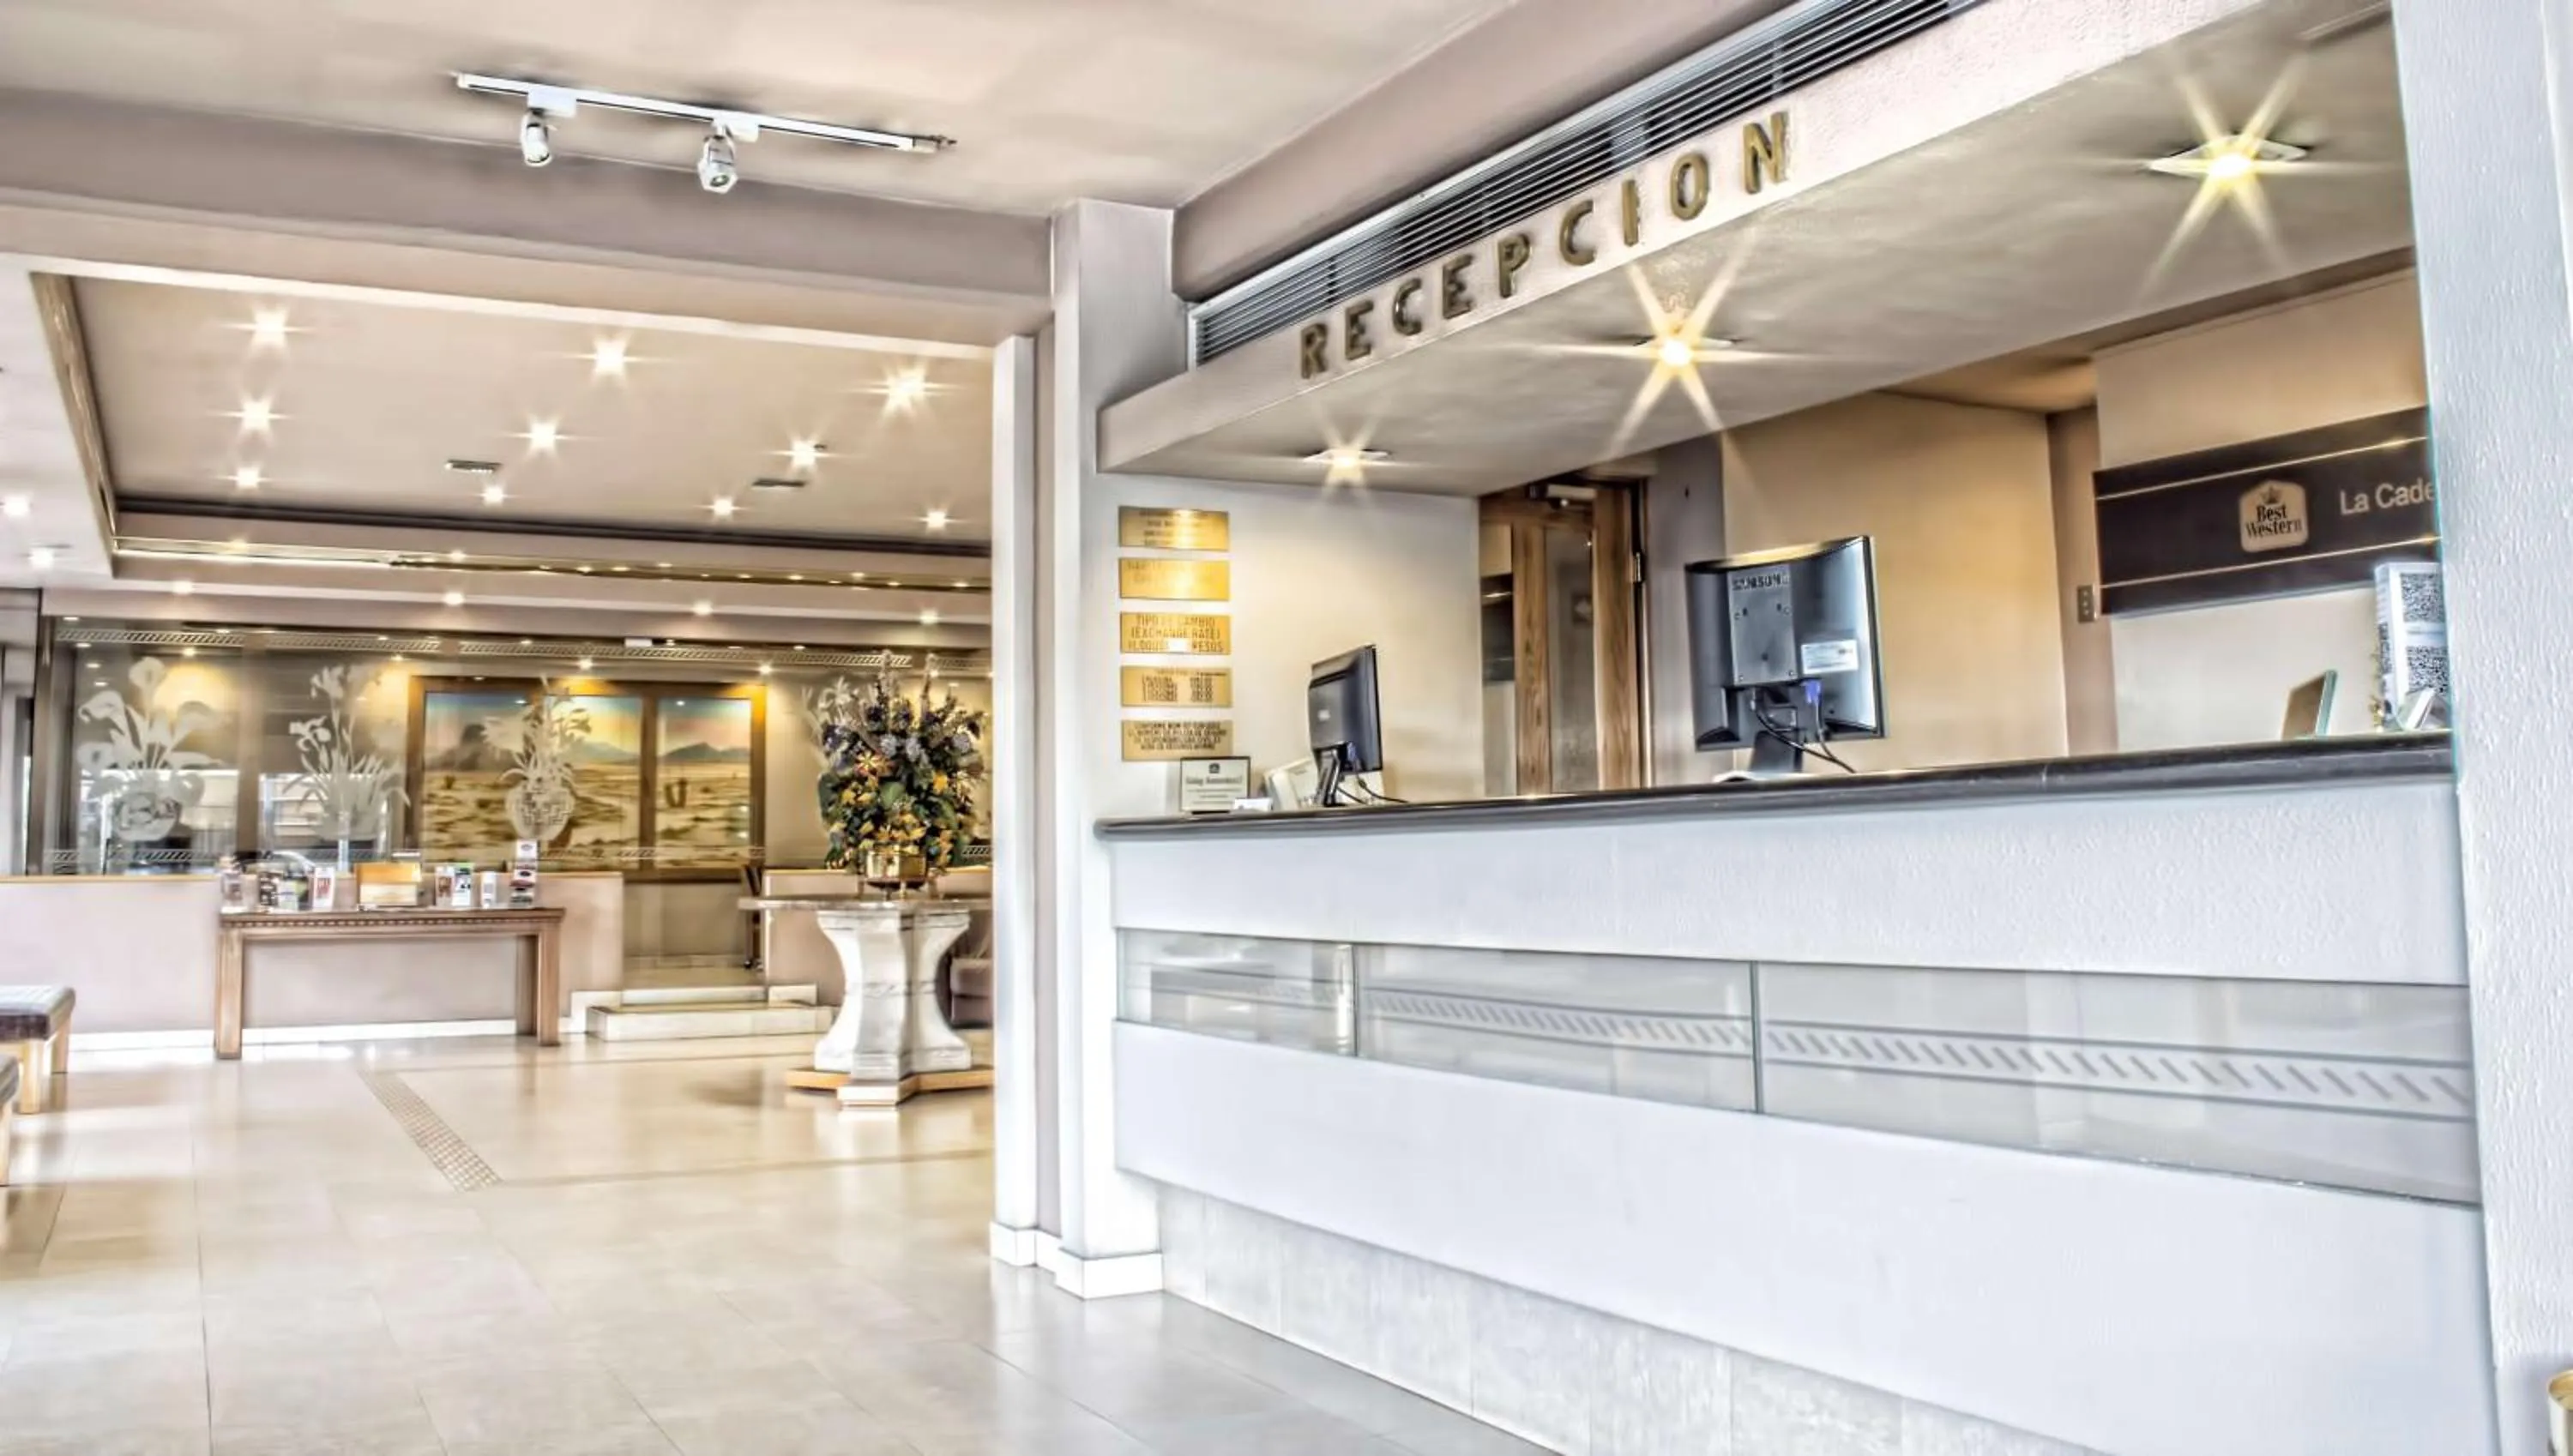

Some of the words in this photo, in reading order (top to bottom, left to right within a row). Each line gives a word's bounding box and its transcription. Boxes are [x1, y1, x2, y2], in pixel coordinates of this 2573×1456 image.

[1300, 111, 1791, 379] RECEPCION
[2256, 503, 2287, 523] Best
[2340, 489, 2370, 515] La
[2245, 518, 2303, 538] Western
